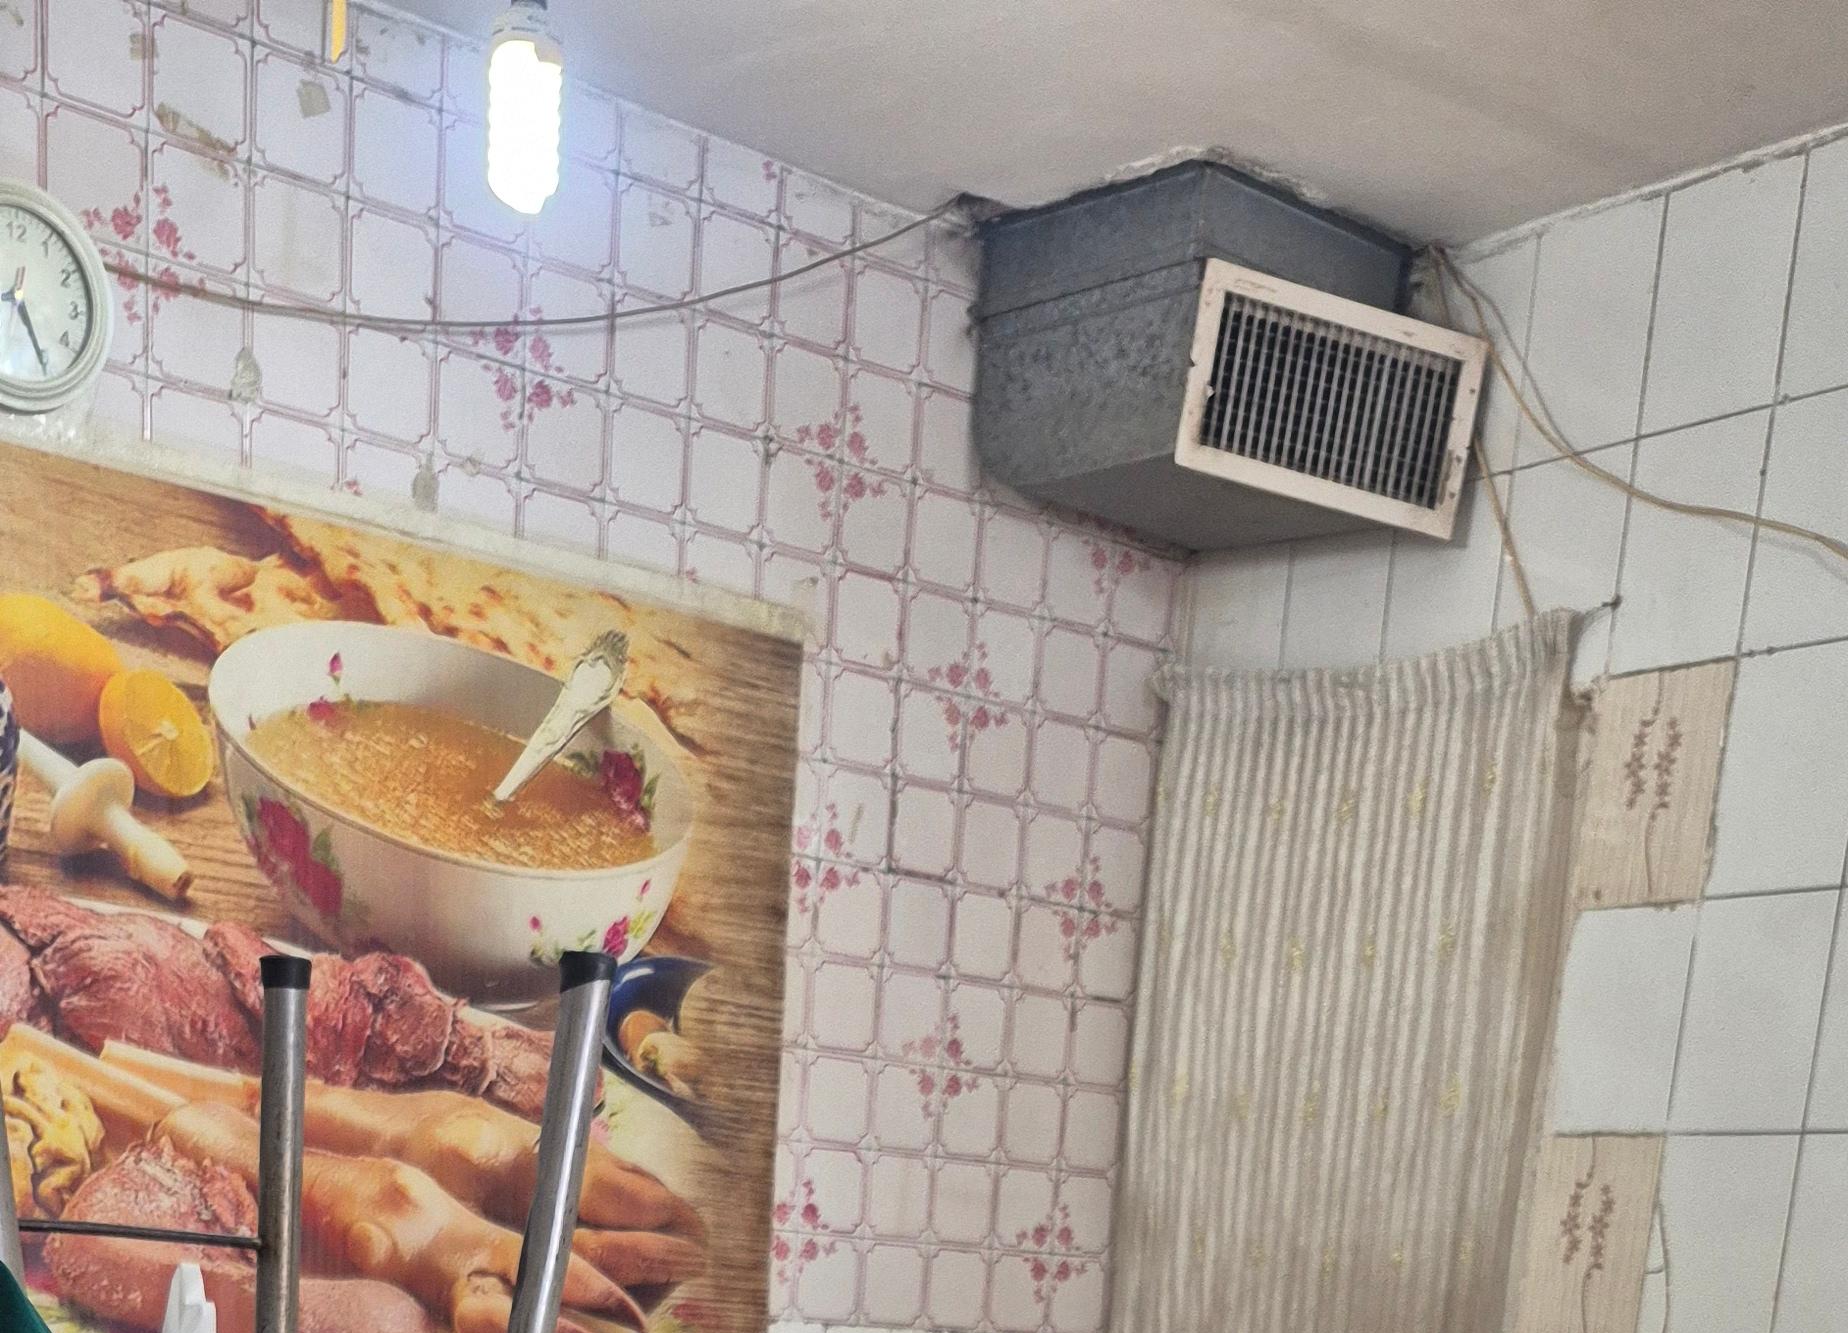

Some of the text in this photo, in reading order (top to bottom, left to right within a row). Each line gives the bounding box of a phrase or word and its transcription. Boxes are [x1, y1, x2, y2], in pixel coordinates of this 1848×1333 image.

[6, 220, 27, 243] 12
[41, 240, 49, 258] 1
[60, 268, 72, 288] 2
[68, 300, 80, 320] 3
[59, 330, 70, 348] 4
